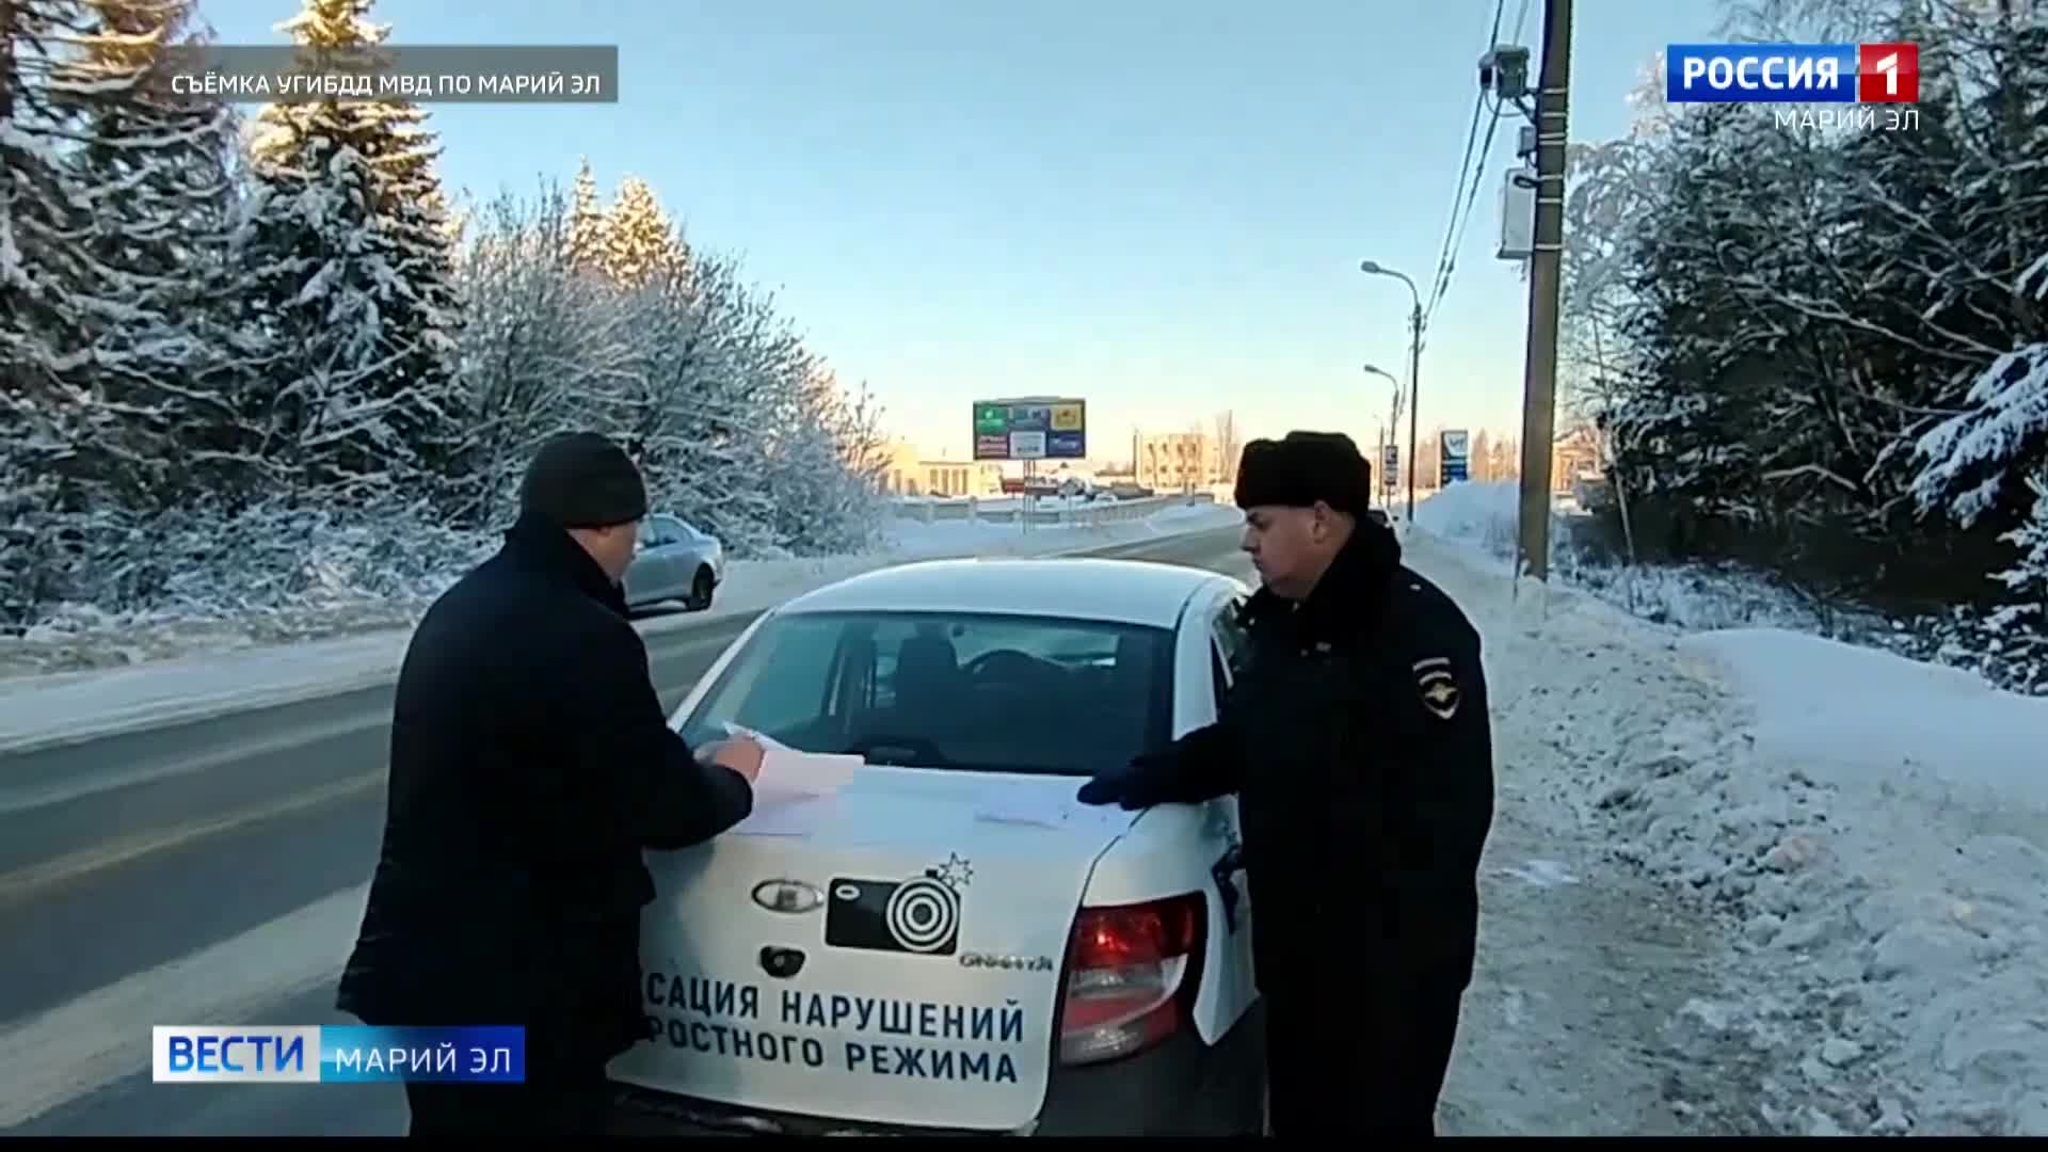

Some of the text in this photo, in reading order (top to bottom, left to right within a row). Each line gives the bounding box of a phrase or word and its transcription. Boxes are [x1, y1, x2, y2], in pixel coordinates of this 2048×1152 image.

[646, 971, 1025, 1043] САЦИЯ НАРУШЕНИЙ
[647, 1015, 1019, 1083] РОСТНОГО РЕЖИМА
